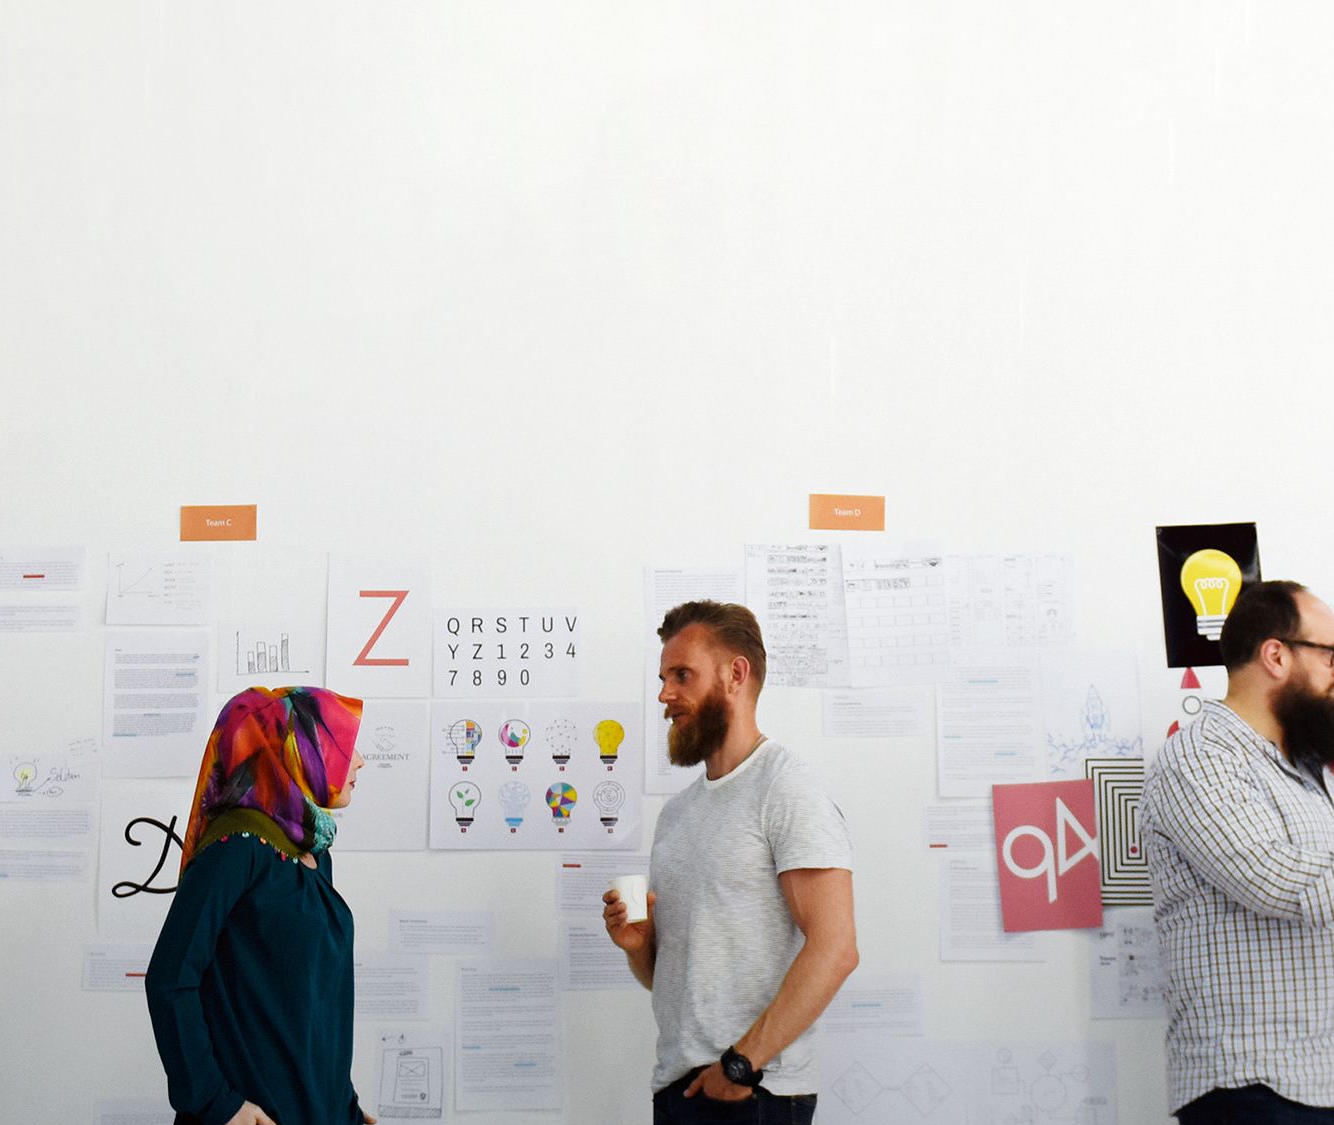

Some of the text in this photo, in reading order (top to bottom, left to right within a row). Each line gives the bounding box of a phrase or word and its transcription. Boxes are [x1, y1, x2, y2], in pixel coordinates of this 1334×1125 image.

[834, 508, 854, 516] Team
[206, 518, 225, 527] Team
[352, 590, 410, 666] Z
[363, 753, 410, 761] AGREEMENT
